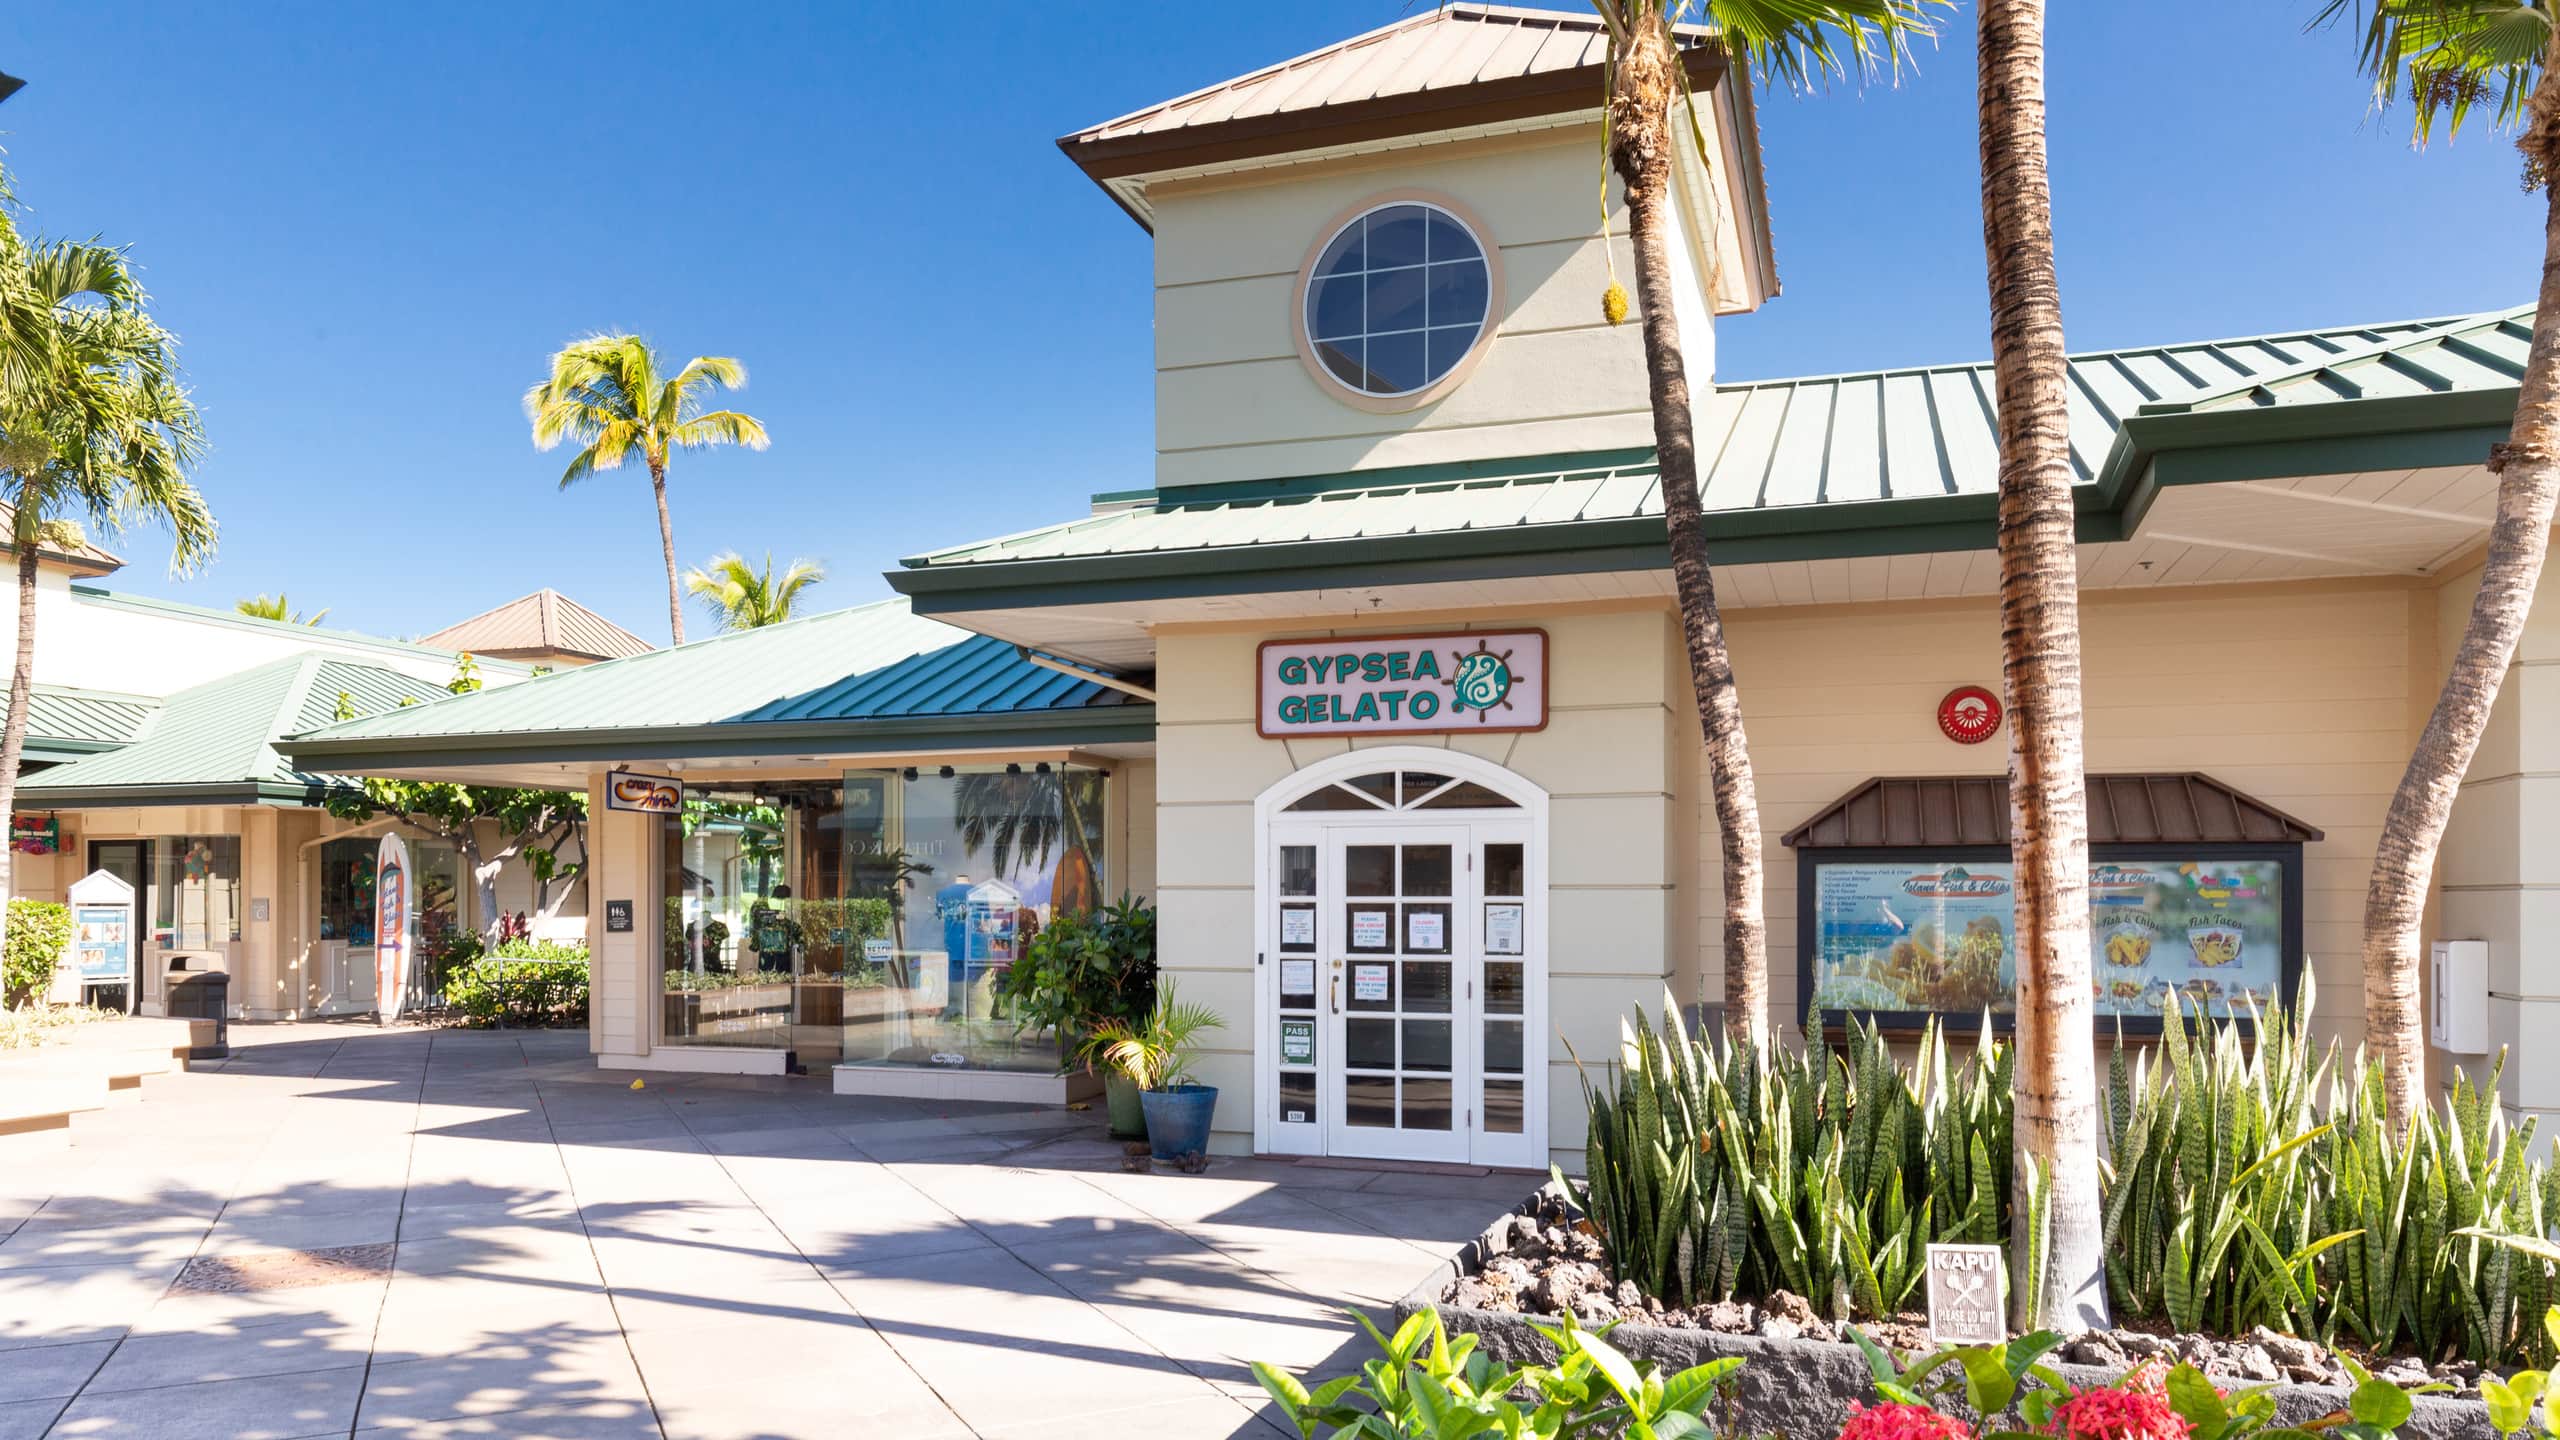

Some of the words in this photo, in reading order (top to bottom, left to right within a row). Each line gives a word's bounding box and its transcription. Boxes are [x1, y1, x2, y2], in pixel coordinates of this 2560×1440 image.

[1278, 650, 1440, 685] GYPSEA
[1278, 690, 1440, 723] GELATO
[1902, 879, 1937, 893] Island
[1942, 879, 1964, 893] Fish
[1967, 880, 1977, 892] &
[1980, 880, 2010, 893] Chips
[2135, 915, 2160, 931] Chips
[2213, 914, 2243, 929] Tacos
[1286, 1027, 1309, 1036] PASS
[1933, 1253, 1995, 1271] KAPU
[1937, 1309, 1964, 1322] PLEASE
[1955, 1323, 1981, 1335] TOUCH
